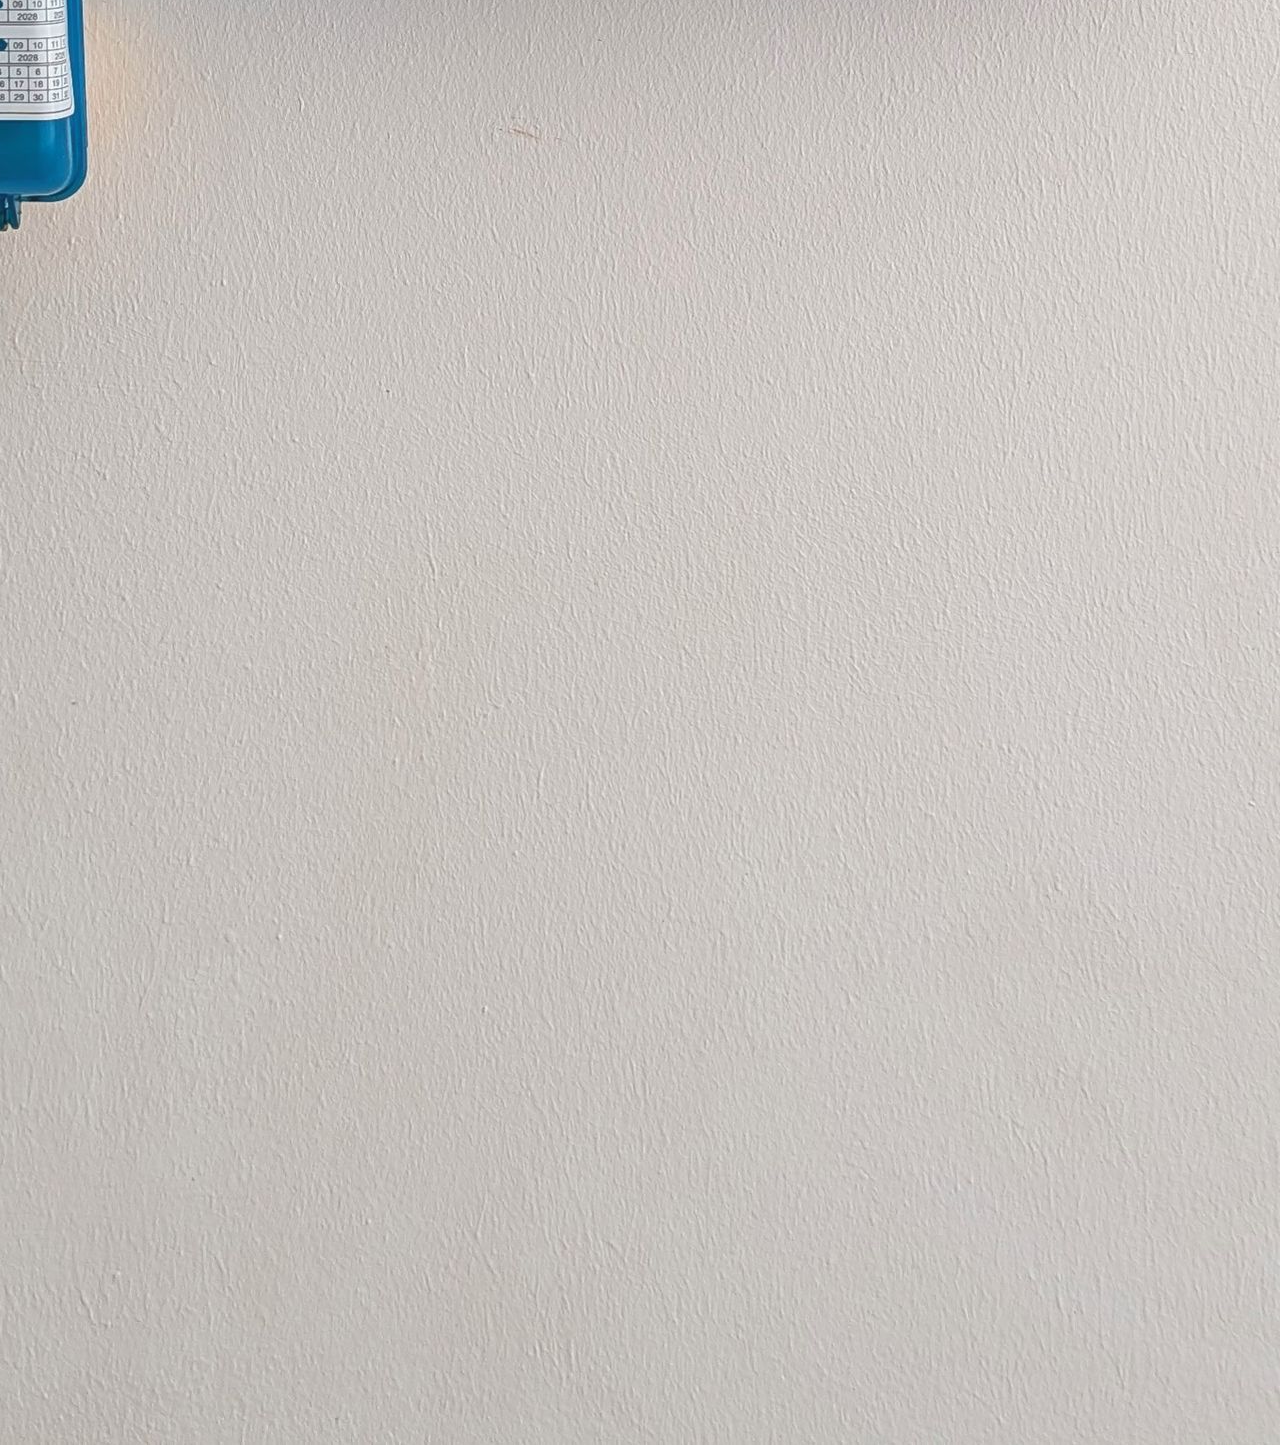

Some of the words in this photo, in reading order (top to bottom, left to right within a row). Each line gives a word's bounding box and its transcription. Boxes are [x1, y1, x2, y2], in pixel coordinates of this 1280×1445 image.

[12, 0, 23, 9] 09
[32, 0, 43, 9] 10
[17, 12, 38, 21] 2028
[12, 41, 24, 50] 09
[33, 41, 43, 50] 10
[17, 54, 39, 62] 2028
[14, 80, 24, 88] 17
[33, 80, 44, 88] 18
[13, 93, 25, 102] 29
[32, 93, 44, 102] 30
